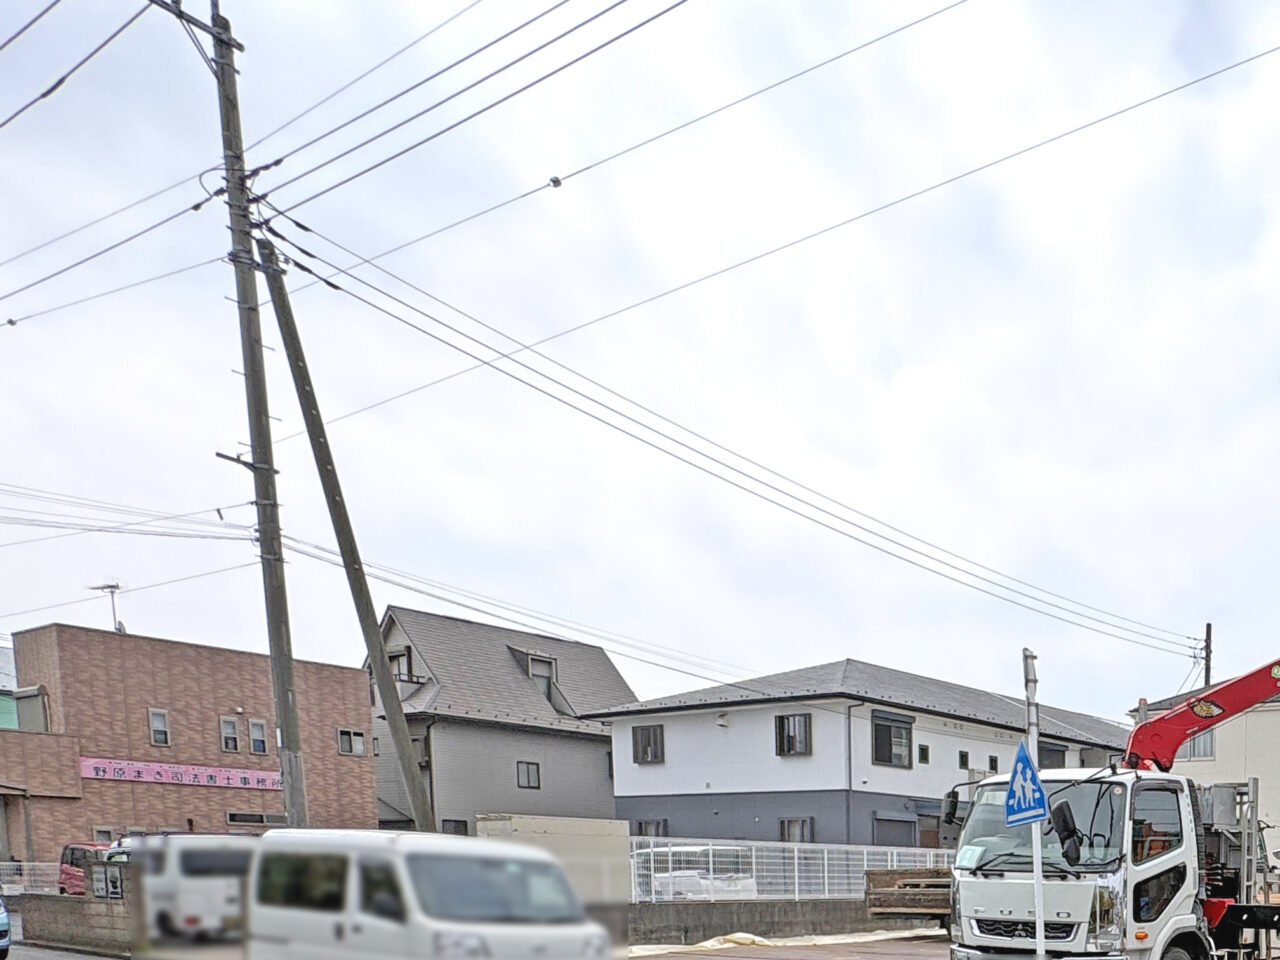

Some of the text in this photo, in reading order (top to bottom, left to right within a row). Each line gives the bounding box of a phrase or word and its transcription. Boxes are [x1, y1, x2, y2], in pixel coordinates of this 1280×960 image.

[93, 766, 284, 788] 野原まき司法書士事務所
